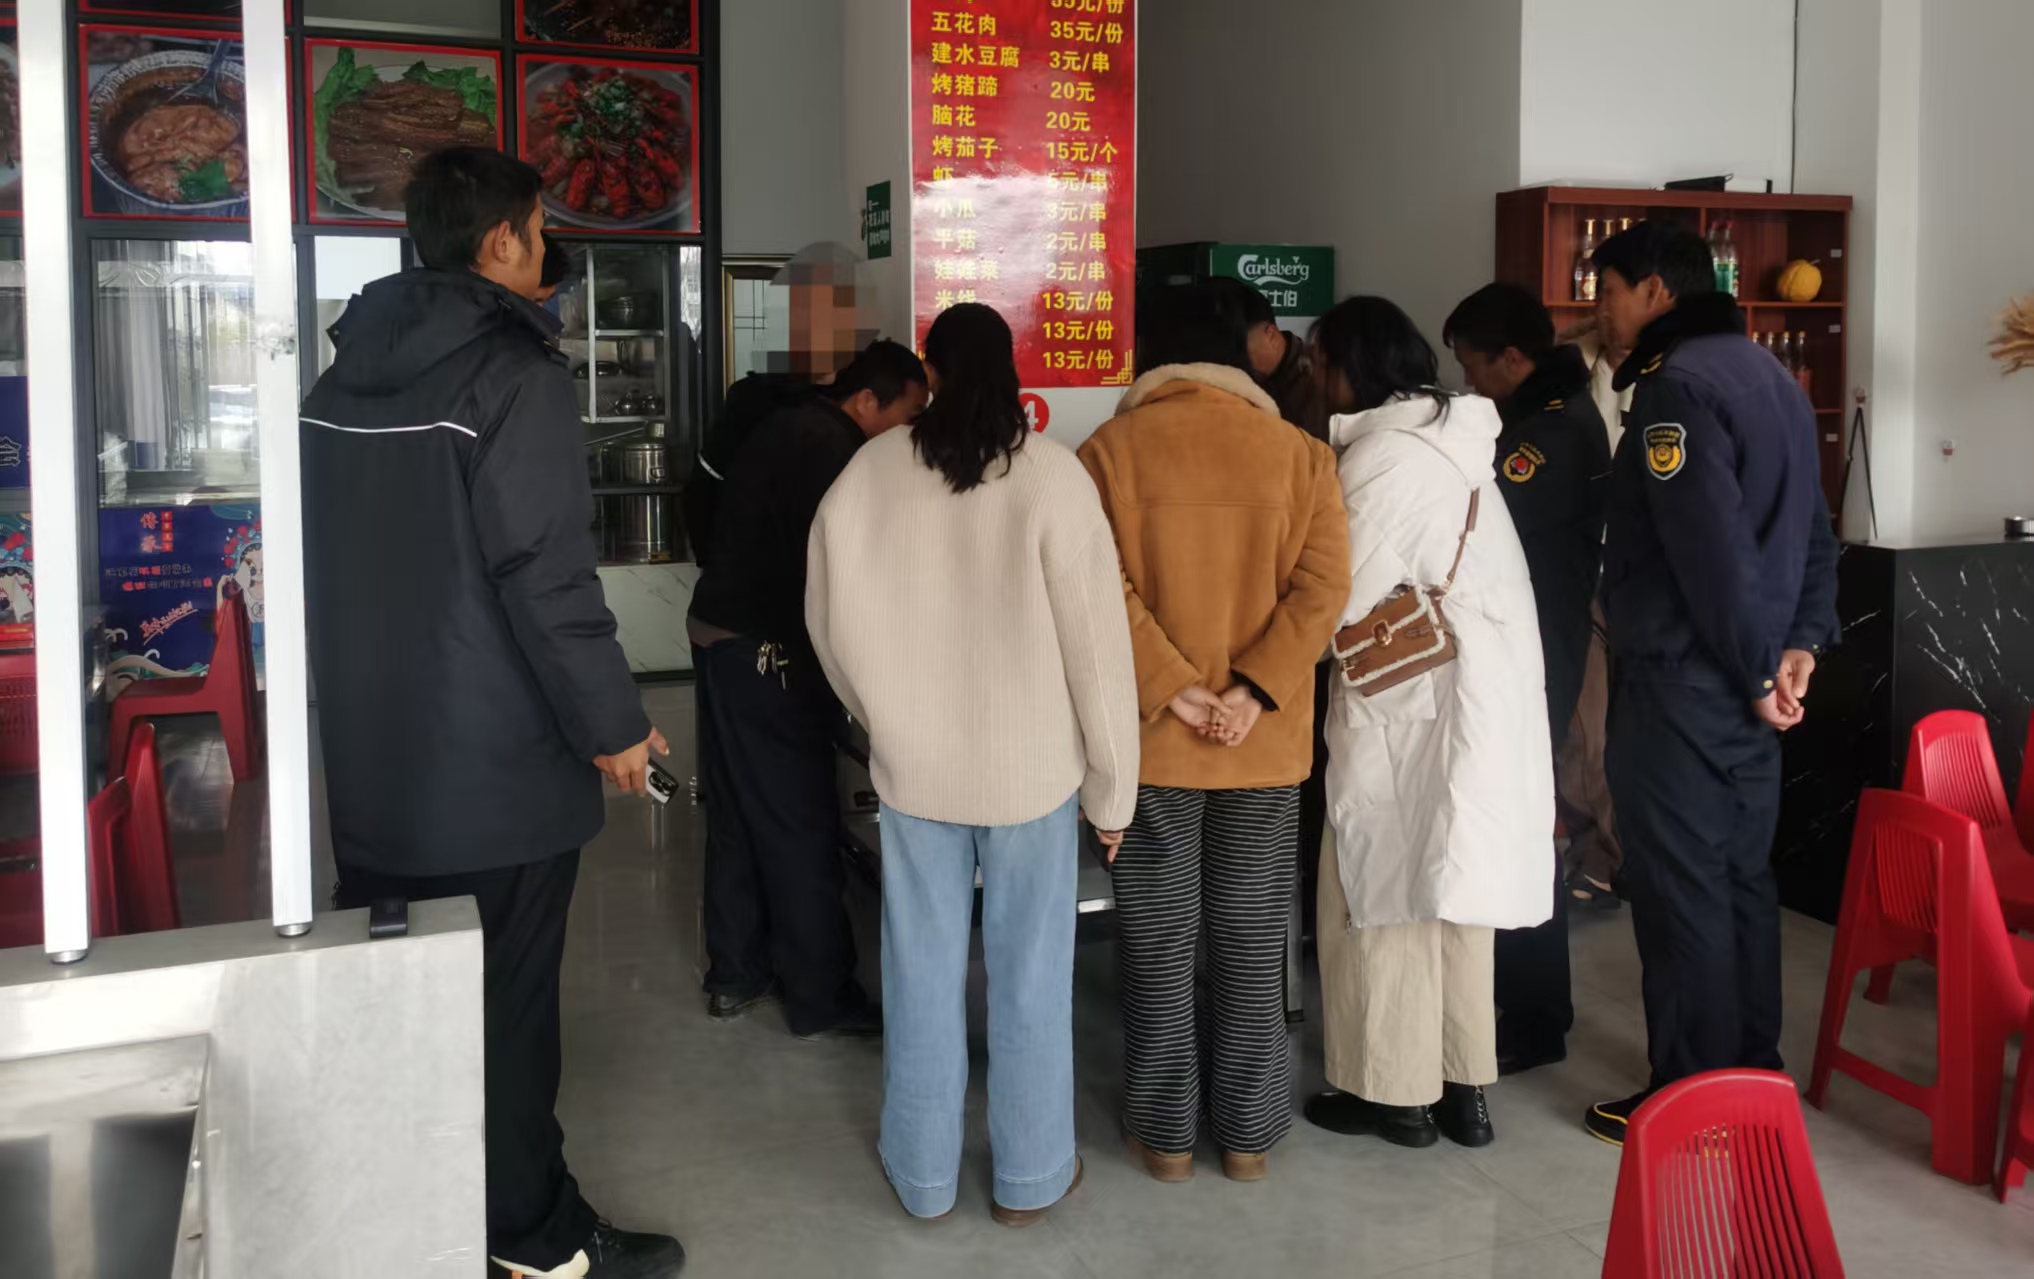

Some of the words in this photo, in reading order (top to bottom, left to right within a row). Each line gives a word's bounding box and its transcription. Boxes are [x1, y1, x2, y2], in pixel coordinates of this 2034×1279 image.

[931, 11, 997, 36] 五花肉
[1050, 21, 1124, 44] 35元/份
[931, 41, 1021, 67] 建水豆腐
[1049, 51, 1110, 73] 3元/串
[931, 72, 998, 97] 烤猪蹄
[1050, 81, 1096, 103] 20元
[932, 104, 976, 127] 脑花
[1046, 111, 1091, 132] 20元
[932, 135, 999, 159] 烤茄子
[1046, 141, 1119, 163] 15元/个
[1046, 200, 1106, 222] 3元/串
[1046, 231, 1106, 252] 2元/串
[1045, 260, 1106, 281] 2元/串
[1237, 253, 1310, 282] Carlsberg
[1042, 291, 1113, 312] 13元/份
[1258, 289, 1298, 308] 士伯
[1042, 320, 1114, 341] 13元/份
[1042, 349, 1114, 370] 13元/份
